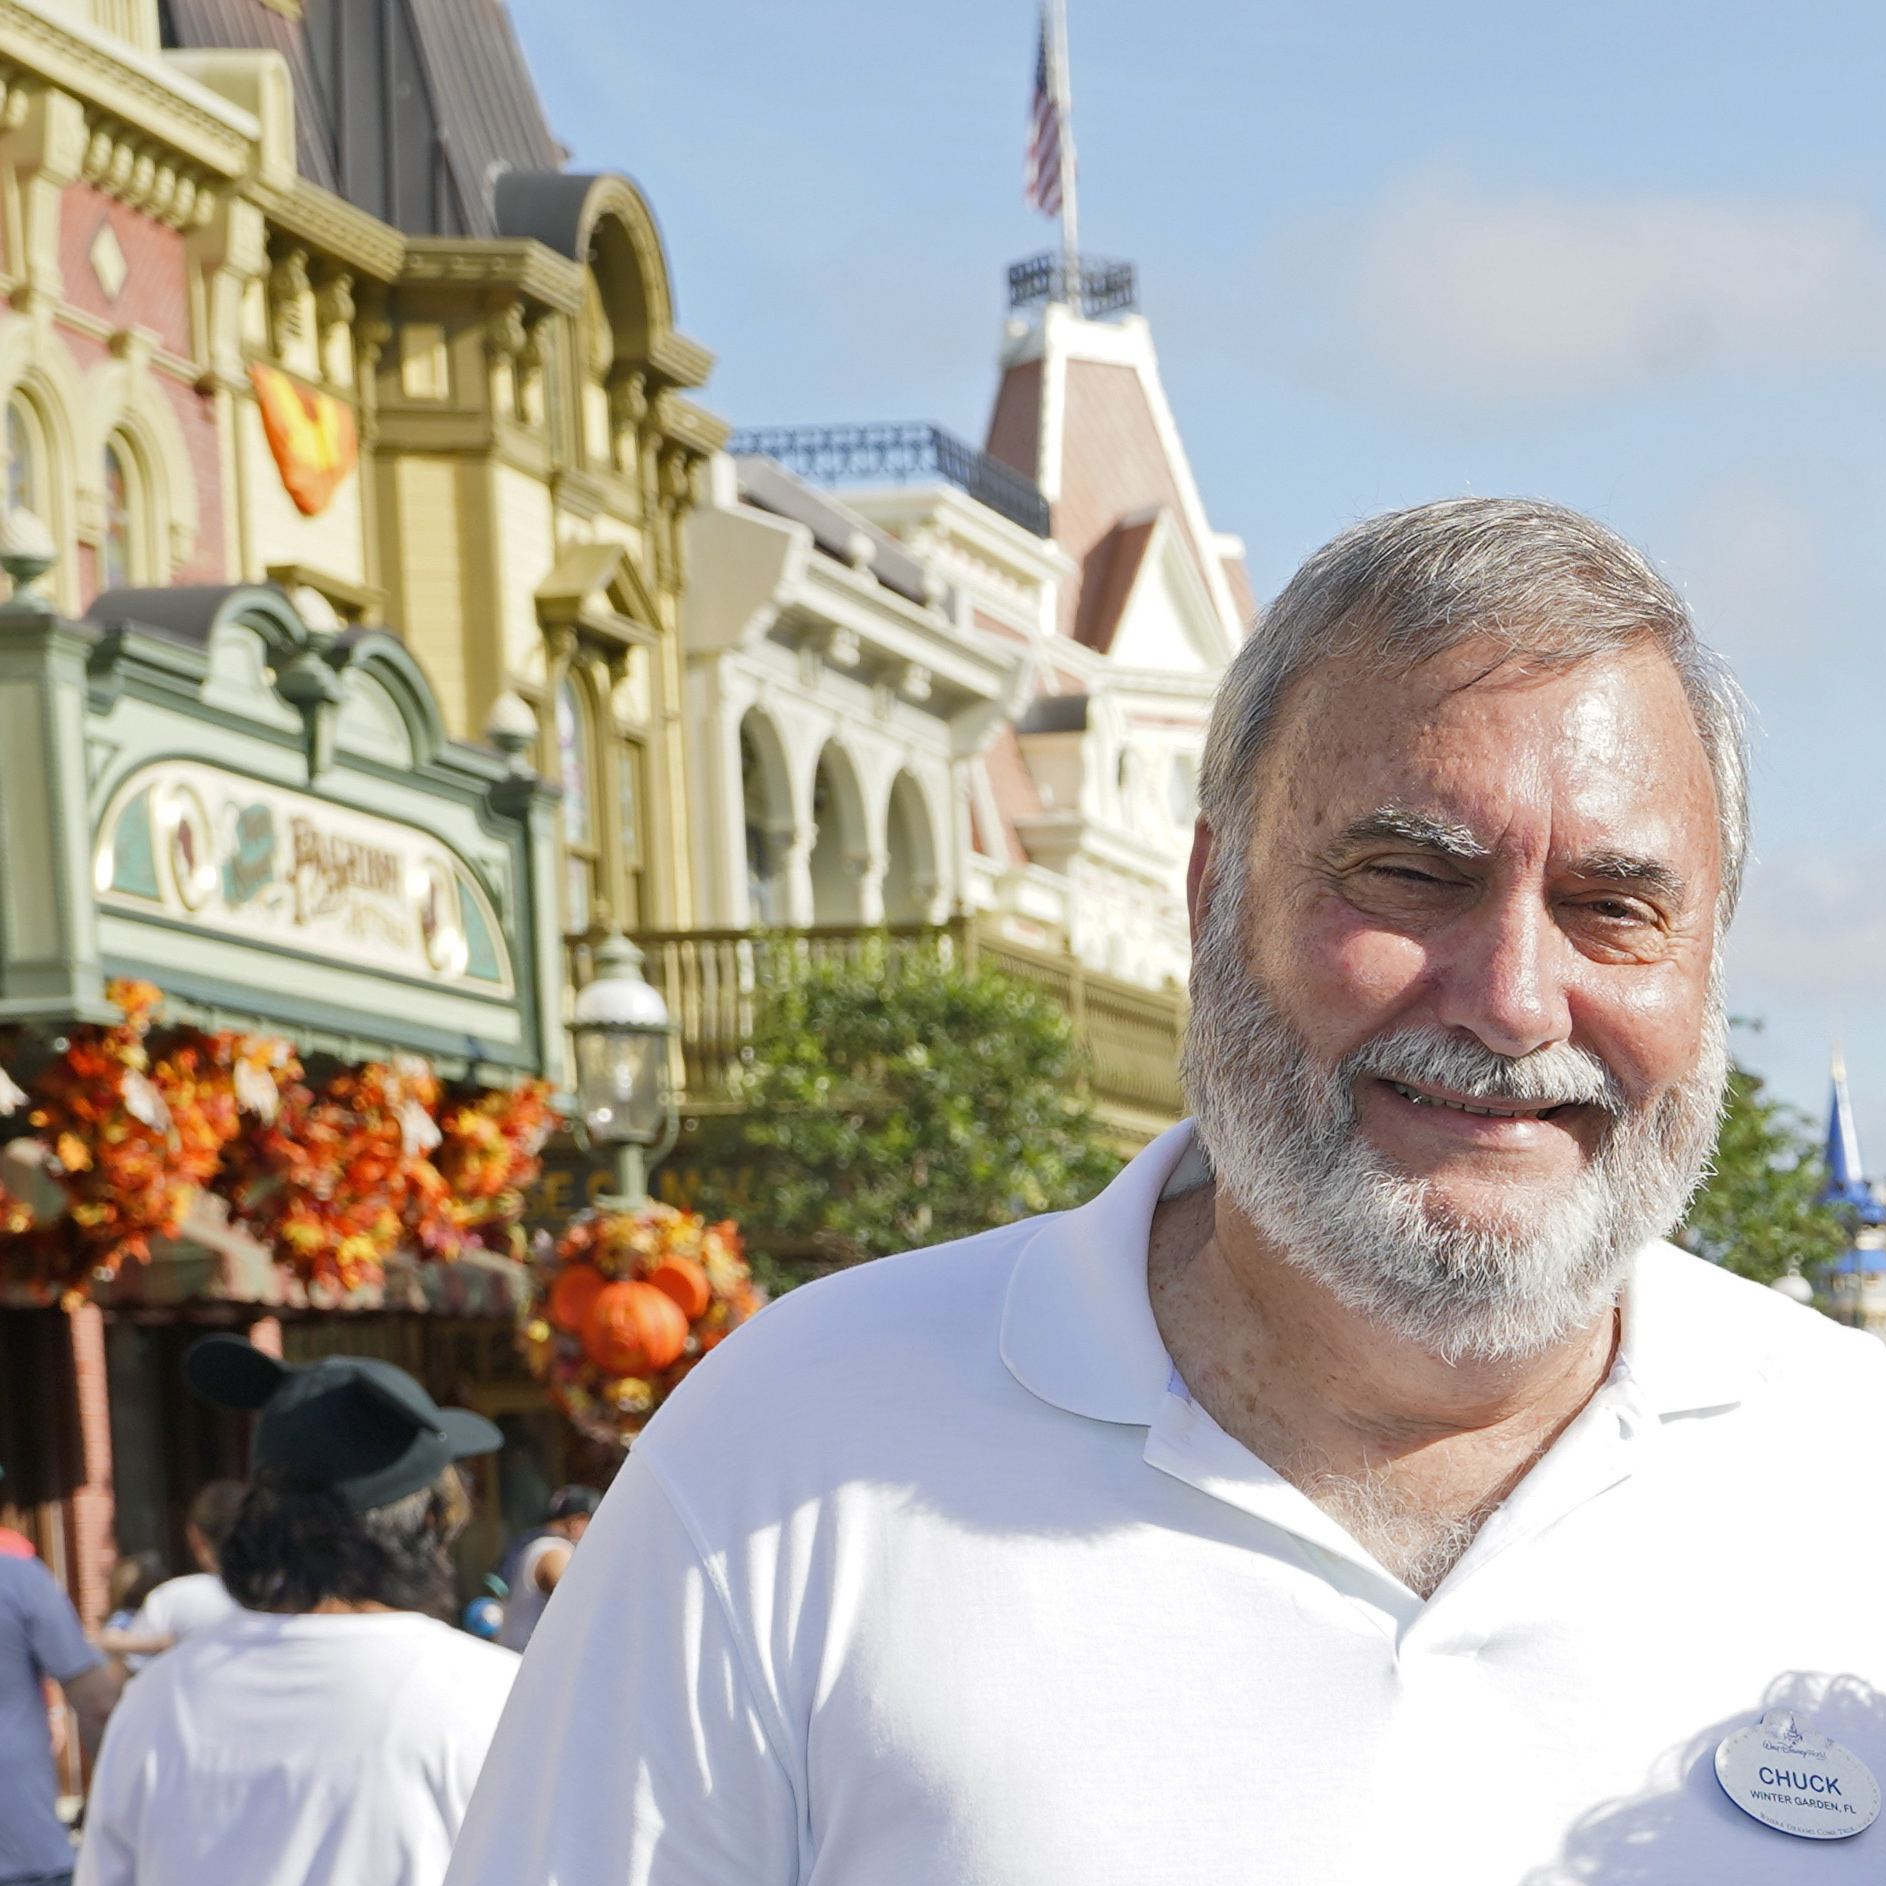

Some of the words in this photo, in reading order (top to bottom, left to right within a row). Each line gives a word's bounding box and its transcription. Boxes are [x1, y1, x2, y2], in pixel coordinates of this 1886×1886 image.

[1759, 1767, 1842, 1796] CHUCK
[1750, 1790, 1792, 1804] WINTER
[1795, 1797, 1842, 1813] GARDEN,
[1844, 1804, 1857, 1814] FL
